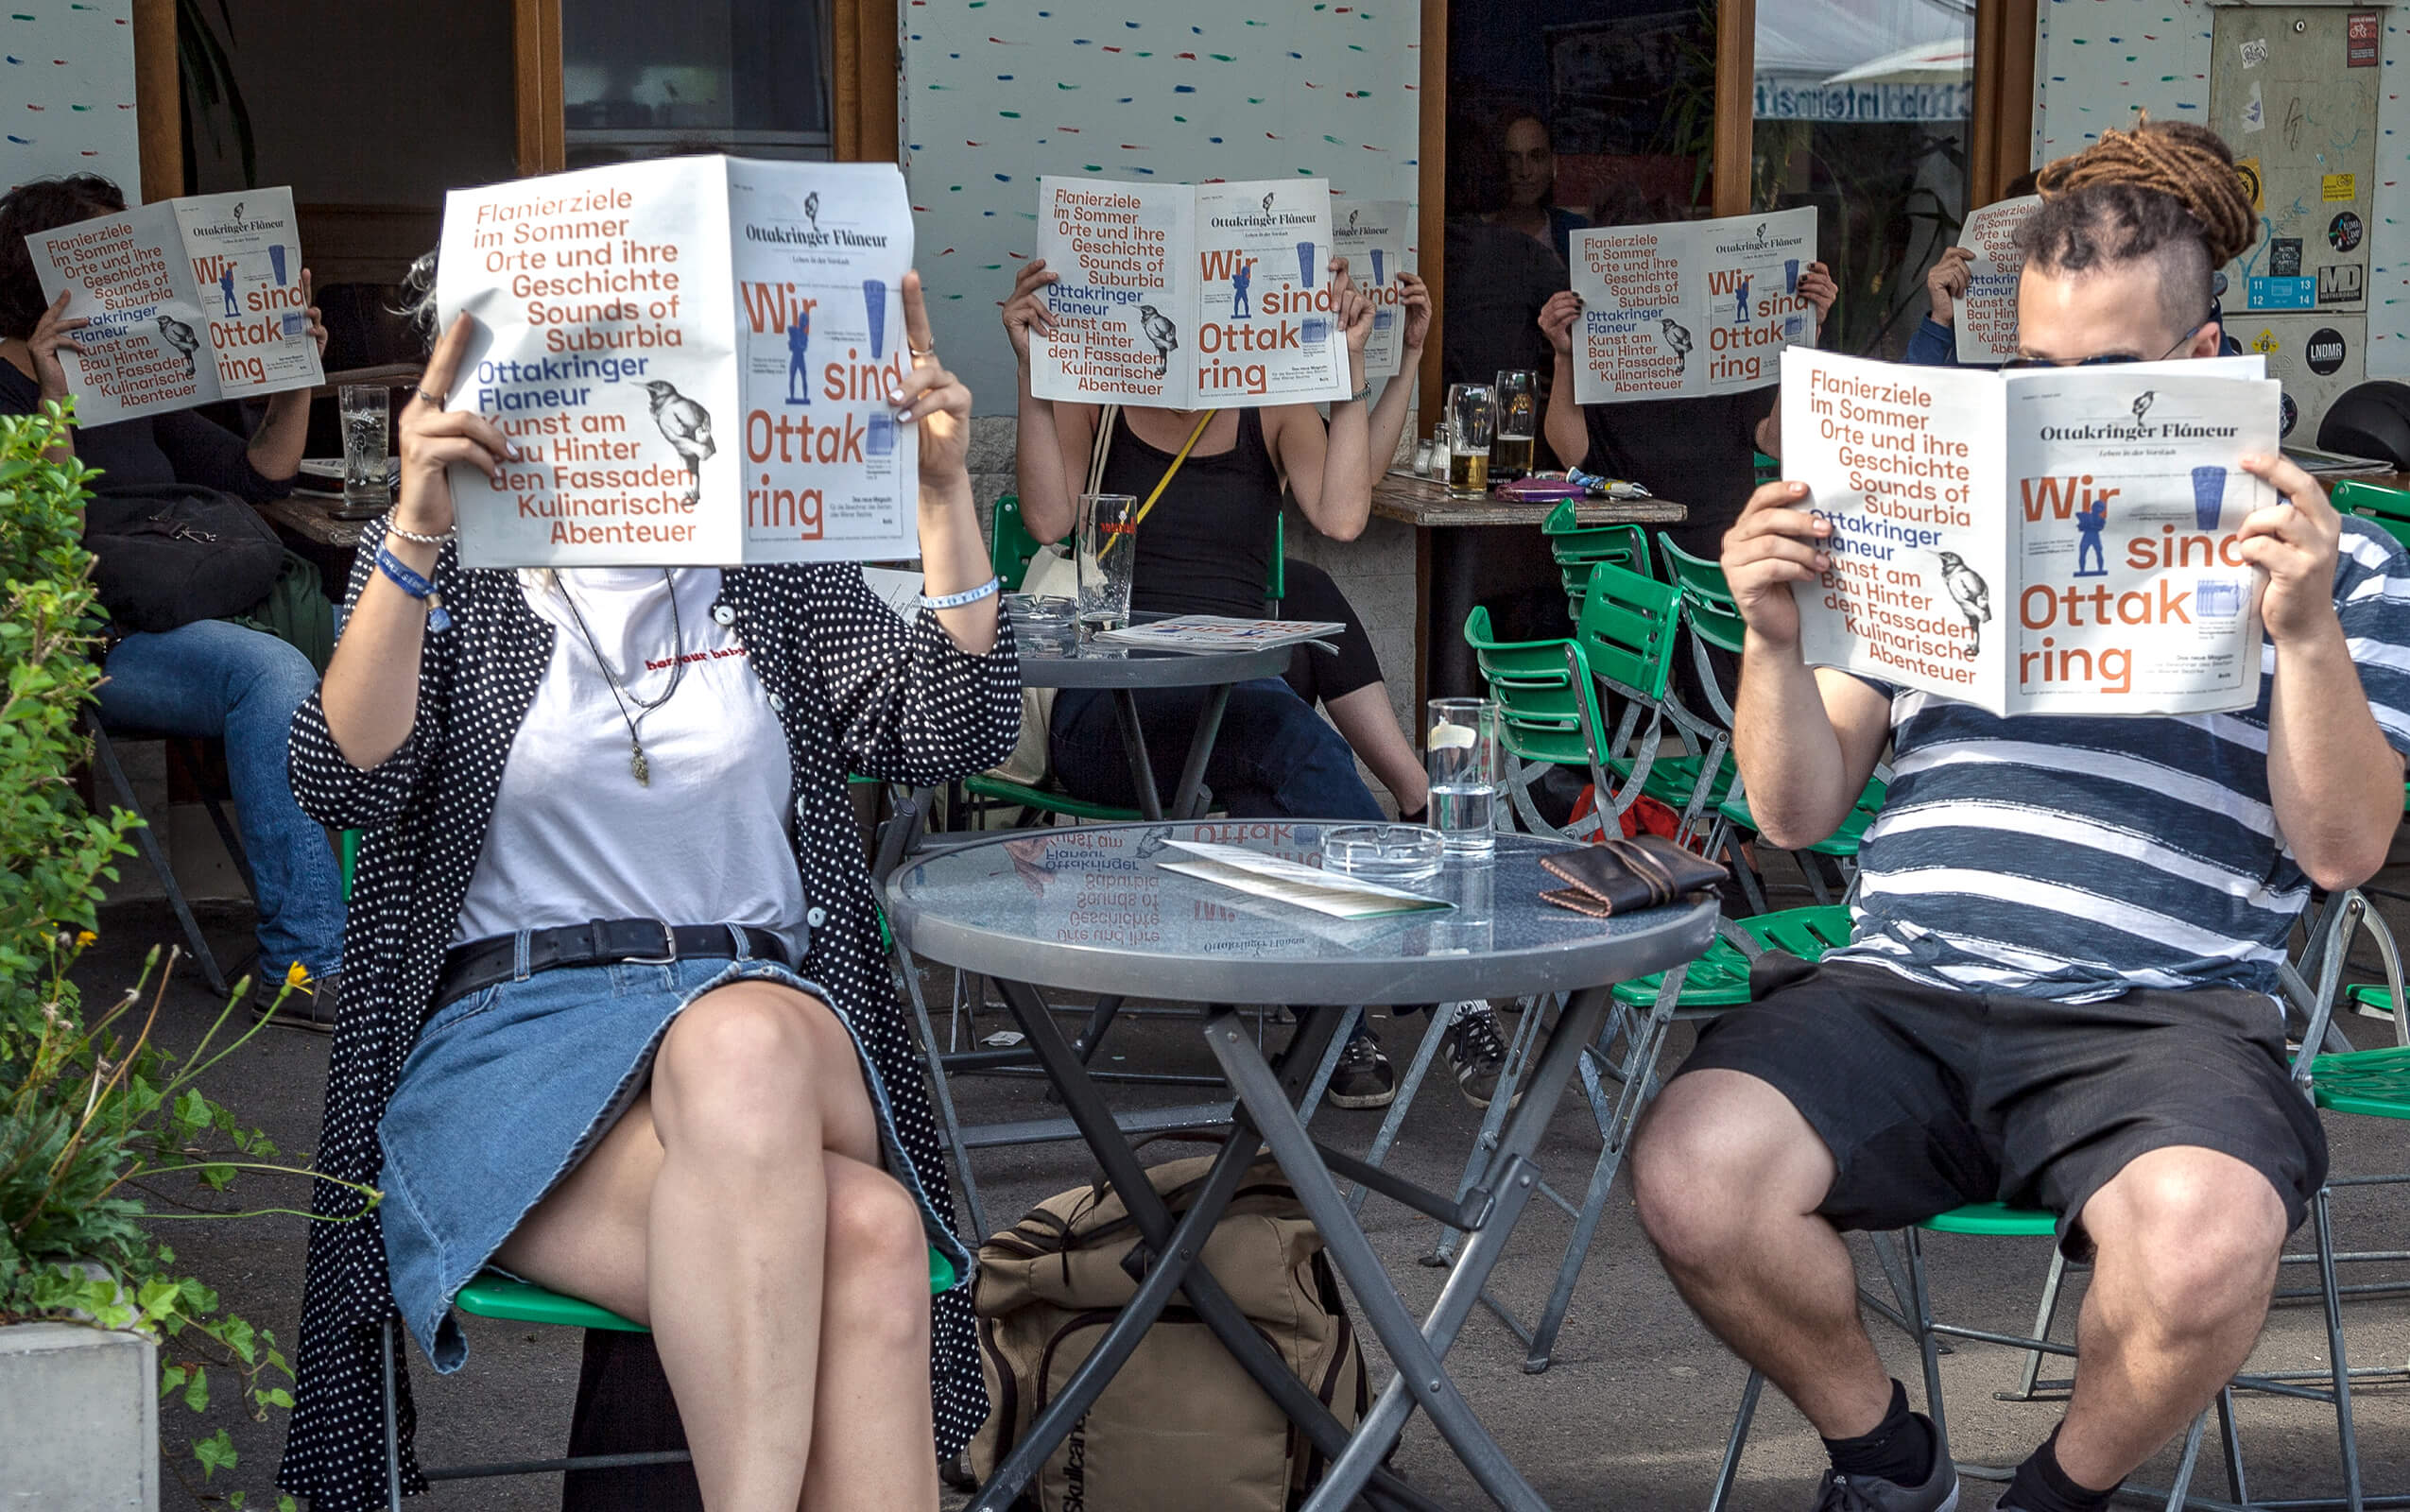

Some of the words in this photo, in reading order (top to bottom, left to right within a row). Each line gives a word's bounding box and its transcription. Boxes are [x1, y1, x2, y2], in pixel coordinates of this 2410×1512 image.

[476, 187, 632, 225] Flanierziele
[1055, 188, 1142, 210] Flanierziele
[1053, 203, 1070, 220] im
[1073, 205, 1140, 225] Sommer
[1211, 215, 1277, 229] Ottakringer
[1975, 203, 2037, 224] Flanierziele
[46, 223, 133, 254] Flanierziele
[193, 223, 249, 237] Ottakringer
[473, 229, 504, 249] im
[513, 217, 629, 245] Sommer
[745, 223, 830, 248] Ottakringer
[1059, 220, 1093, 237] Orte
[1096, 226, 1128, 240] und
[1133, 226, 1165, 242] ihre
[1971, 220, 1985, 233] im
[1974, 230, 2000, 242] Orte
[51, 254, 71, 268] im
[74, 237, 134, 262] Sommer
[1072, 237, 1165, 258] Geschichte
[1584, 233, 1659, 249] Flanierziele
[64, 262, 98, 280] Orte
[101, 252, 130, 270] und
[134, 246, 163, 263] ihre
[486, 249, 546, 273] Orte
[557, 241, 612, 268] und
[622, 239, 680, 265] ihre
[1078, 253, 1142, 272] Sounds
[1146, 257, 1165, 273] of
[1200, 249, 1259, 283] Wir
[1584, 250, 1599, 262] im
[1603, 248, 1657, 261] Sommer
[1591, 260, 1620, 273] Orte
[1624, 258, 1649, 271] und
[1653, 256, 1678, 269] ihre
[83, 259, 166, 289] Geschichte
[192, 254, 238, 285] Wir
[1088, 269, 1165, 288] Suburbia
[1604, 269, 1678, 285] Geschichte
[1708, 268, 1755, 296] Wir
[1968, 274, 2019, 284] Ottakrin
[2320, 266, 2361, 293] MD
[95, 278, 150, 300] Sounds
[153, 271, 170, 286] of
[511, 266, 680, 299] Geschichte
[1047, 284, 1145, 305] Ottakringer
[1363, 280, 1399, 306] ind
[1610, 283, 1661, 297] Sounds
[1664, 281, 1679, 293] of
[1966, 284, 2014, 297] Flaneur
[2253, 280, 2264, 290] 11
[2299, 279, 2312, 290] 13
[105, 287, 174, 310] Suburbia
[247, 279, 303, 312] sind
[740, 280, 818, 335] Wir
[1048, 298, 1110, 317] Flaneur
[1262, 281, 1333, 315] sind
[1619, 293, 1679, 308] Suburbia
[1966, 298, 2005, 309] Kunst
[2252, 295, 2264, 306] 12
[2298, 294, 2310, 305] 14
[87, 304, 158, 327] takringer
[527, 297, 639, 327] Sounds
[649, 295, 680, 318] of
[1586, 307, 1664, 323] Ottakringer
[1966, 308, 1991, 320] Bau
[72, 324, 129, 343] Flaneur
[210, 316, 284, 350] Ottak
[546, 322, 682, 353] Suburbia
[1047, 328, 1081, 344] Bau
[1085, 331, 1135, 349] Hinter
[1101, 319, 1128, 334] am
[1198, 319, 1300, 353] Ottak
[1587, 321, 1637, 335] Flaneur
[1710, 319, 1785, 352] Ottak
[1968, 320, 1990, 333] den
[126, 335, 150, 348] am
[1588, 333, 1627, 347] Kunst
[1630, 333, 1652, 344] am
[1588, 347, 1614, 359] Bau
[1618, 344, 1659, 357] Hinter
[79, 357, 111, 372] Bau
[113, 347, 160, 366] Hinter
[1047, 345, 1079, 360] den
[1084, 346, 1163, 366] Fassaden
[1589, 358, 1614, 370] den
[1617, 354, 1682, 369] Fassaden
[1710, 353, 1760, 381] ring
[84, 369, 113, 387] den
[116, 354, 191, 380] Fassaden
[218, 352, 267, 385] ring
[478, 354, 649, 385] Ottakringer
[1061, 360, 1164, 380] Kulinarische
[1198, 357, 1267, 395] ring
[1600, 367, 1682, 383] Kulinarische
[100, 369, 196, 398] Kulinarische
[121, 383, 198, 408] Abenteuer
[1077, 377, 1164, 396] Abenteuer
[1614, 378, 1684, 393] Abenteuer
[1810, 369, 1932, 407] Flanierziele
[478, 386, 591, 414] Flaneur
[1810, 392, 1833, 416] im
[1839, 398, 1930, 431] Sommer
[581, 414, 627, 435] am
[746, 409, 866, 464] Ottak
[2040, 424, 2158, 442] Ottakringer
[552, 437, 641, 463] Hinter
[1820, 418, 1865, 446] Orte
[1871, 432, 1915, 453] und
[1922, 434, 1970, 458] ihre
[1838, 445, 1970, 482] Geschichte
[489, 466, 544, 492] den
[553, 462, 695, 490] Fassaden
[1849, 471, 1937, 501] Sounds
[1944, 484, 1971, 504] of
[518, 490, 697, 519] Kulinarische
[748, 472, 824, 541] ring
[1864, 493, 1971, 527] Suburbia
[2021, 474, 2120, 523] Wir
[550, 520, 697, 546] Abenteuer
[1820, 570, 1861, 597] Bau
[1866, 580, 1934, 611] Hinter
[1885, 570, 1922, 589] am
[1824, 593, 1862, 616] den
[1868, 602, 1974, 640] Fassaden
[2020, 578, 2192, 630] Ottak
[1844, 614, 1977, 663] Kulinarische
[708, 646, 747, 660] baby
[1869, 642, 1977, 685] Abenteuer
[2020, 636, 2132, 694] ring
[1062, 1408, 1091, 1512] Skullcan
